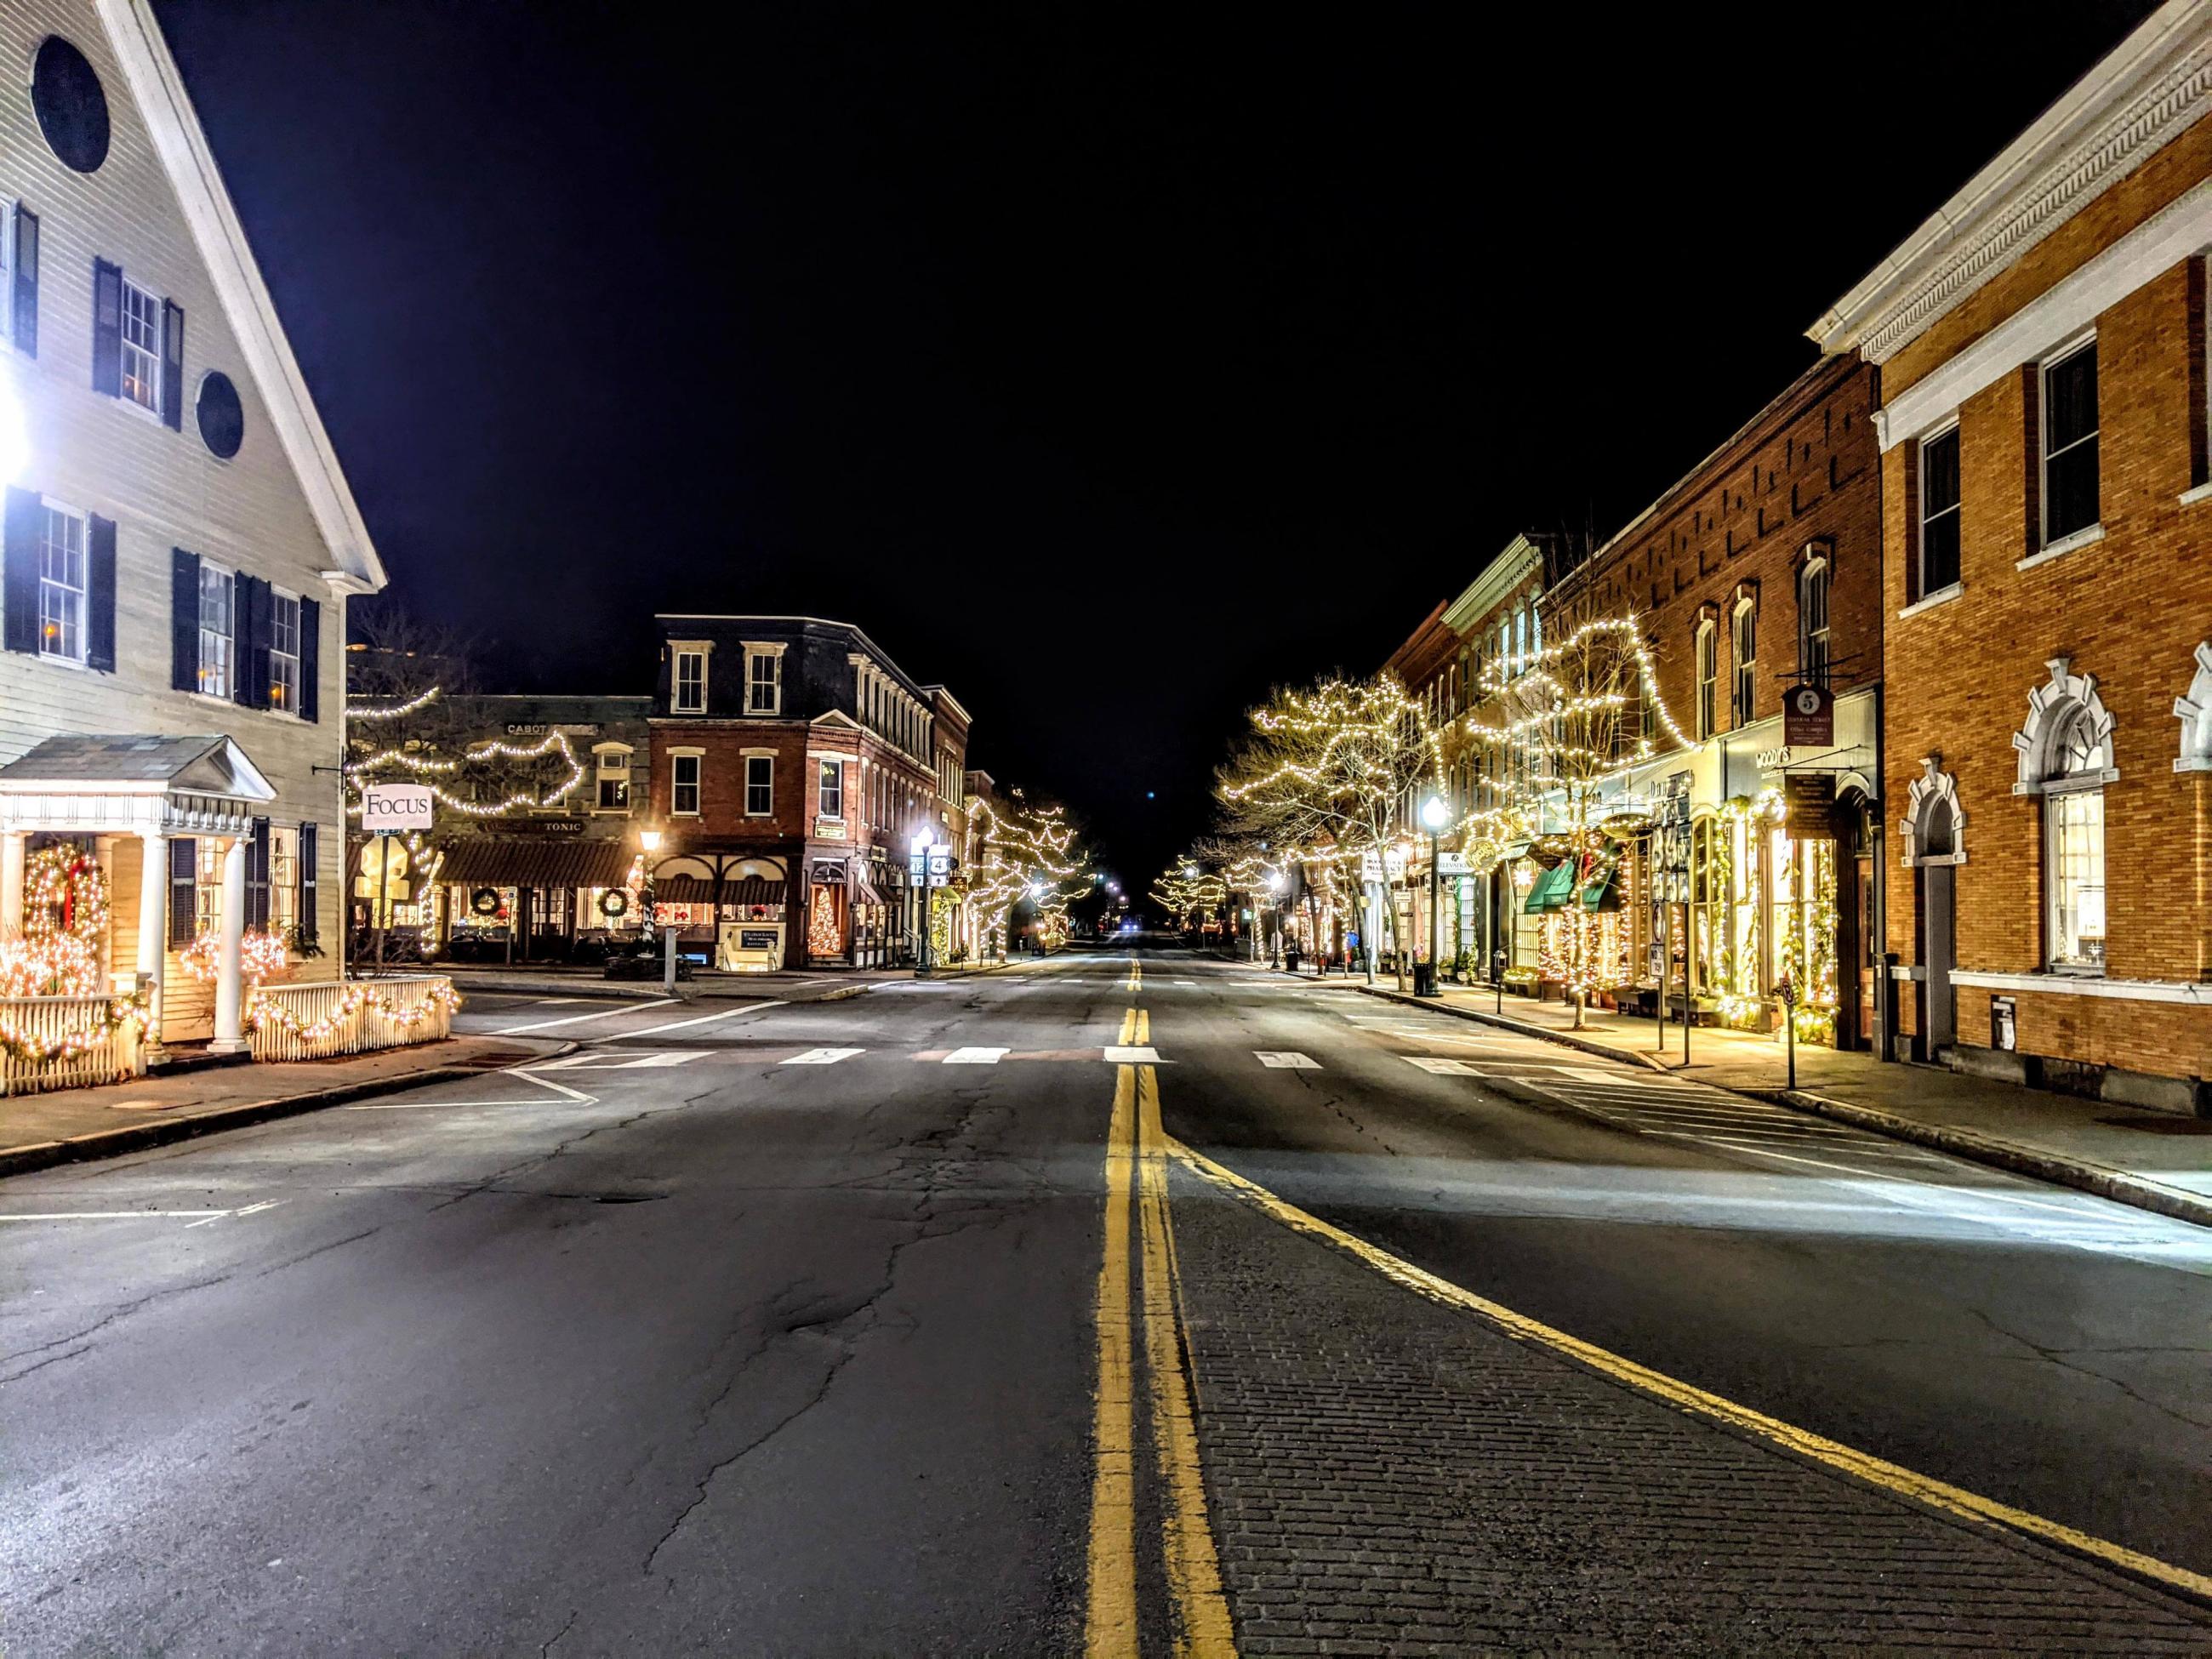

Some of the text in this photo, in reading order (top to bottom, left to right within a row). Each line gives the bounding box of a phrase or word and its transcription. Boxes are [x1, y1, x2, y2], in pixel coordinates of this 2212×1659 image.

[1803, 694, 1813, 710] 5
[507, 725, 547, 733] CABOT
[1755, 746, 1790, 769] WOODY'S
[366, 794, 429, 815] FOCUS
[544, 823, 581, 831] TONIC
[914, 863, 925, 873] 12
[934, 860, 942, 870] 4
